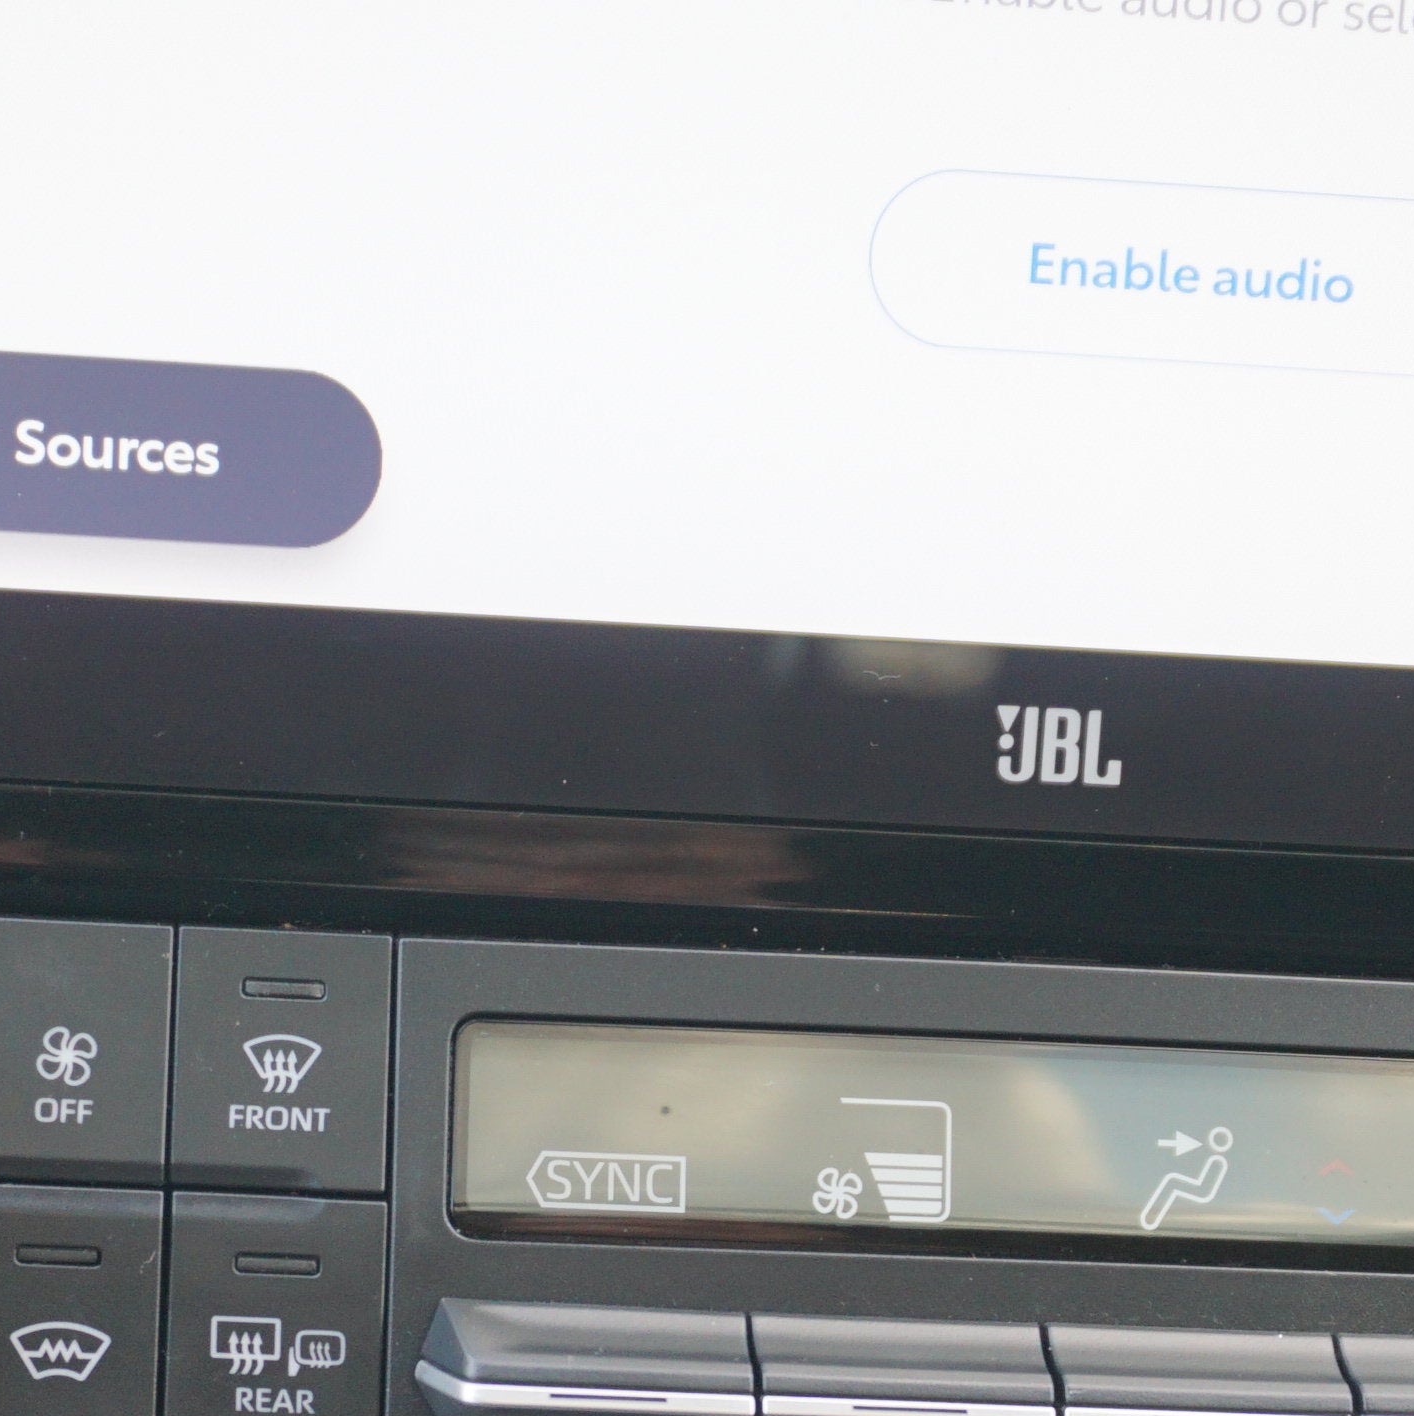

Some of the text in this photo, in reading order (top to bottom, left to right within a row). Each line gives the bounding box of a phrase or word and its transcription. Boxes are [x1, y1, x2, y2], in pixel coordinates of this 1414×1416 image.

[1277, 0, 1328, 28] or
[1029, 243, 1354, 303] Enable audio
[14, 419, 220, 476] Sources
[997, 704, 1122, 786] JBL
[34, 1097, 94, 1124] OFF
[228, 1104, 331, 1132] FRONT
[545, 1159, 674, 1203] SYNC
[235, 1386, 315, 1414] REAR
